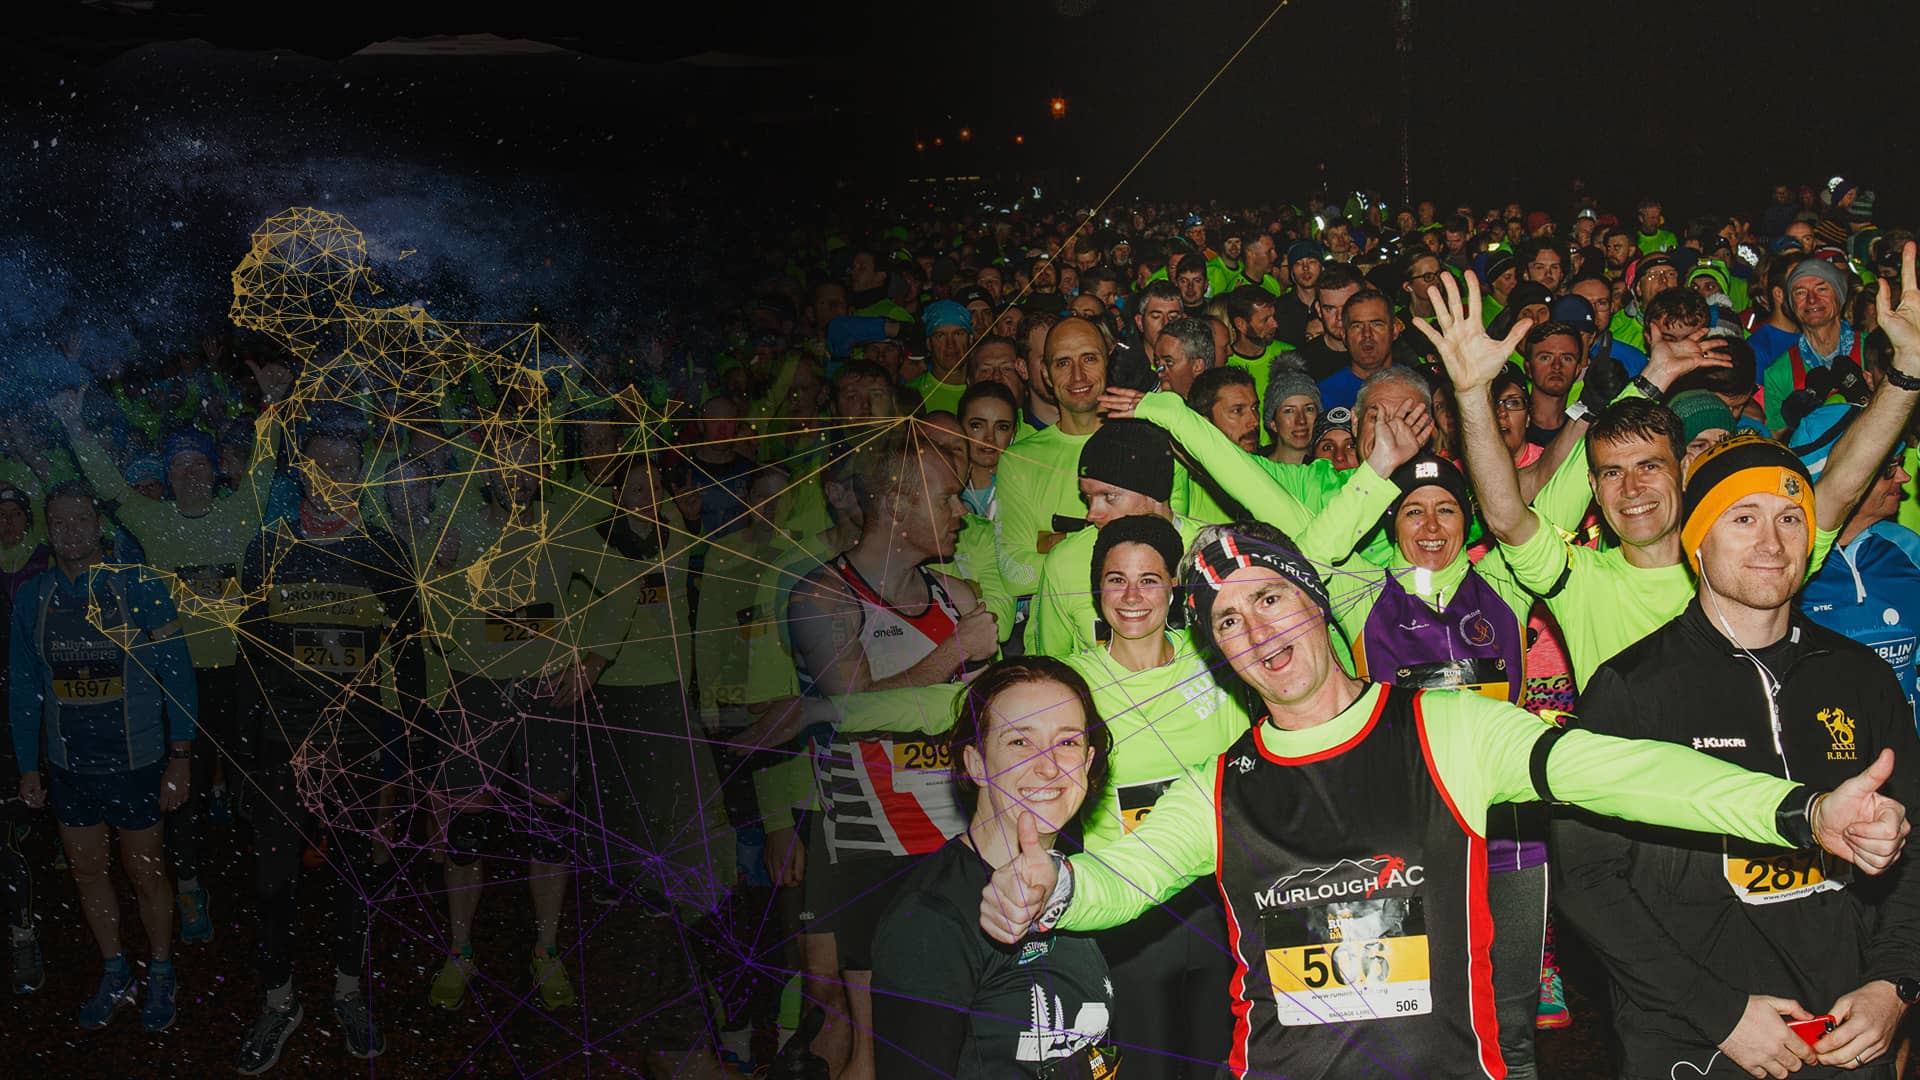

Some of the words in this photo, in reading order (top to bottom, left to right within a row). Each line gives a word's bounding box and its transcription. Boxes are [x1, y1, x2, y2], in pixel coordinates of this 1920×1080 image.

[1875, 643, 1912, 659] BLIN
[64, 679, 111, 698] 1697
[1254, 876, 1379, 910] MURLOUGH
[1386, 865, 1425, 889] AC
[1396, 1000, 1418, 1012] 506
